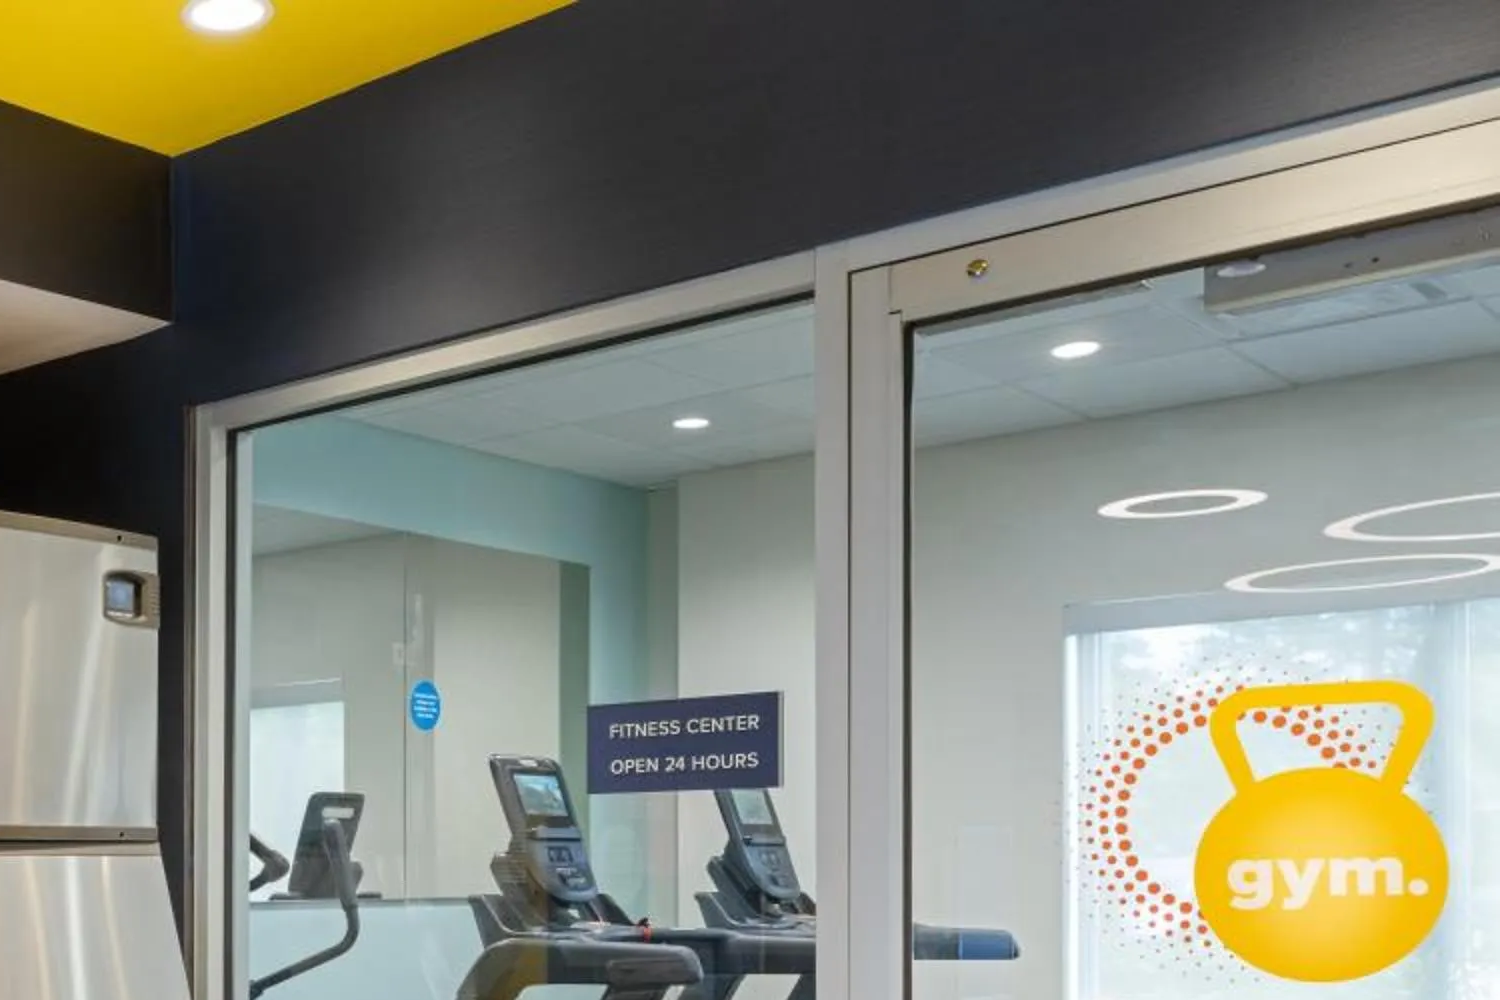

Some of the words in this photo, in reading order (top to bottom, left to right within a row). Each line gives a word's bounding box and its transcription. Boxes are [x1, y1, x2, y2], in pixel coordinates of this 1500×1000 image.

[609, 720, 680, 740] FITNESS
[687, 714, 760, 734] CENTER
[610, 757, 660, 775] OPEN
[665, 756, 685, 772] 24
[691, 752, 760, 771] HOURS
[1227, 856, 1430, 911] gym.
